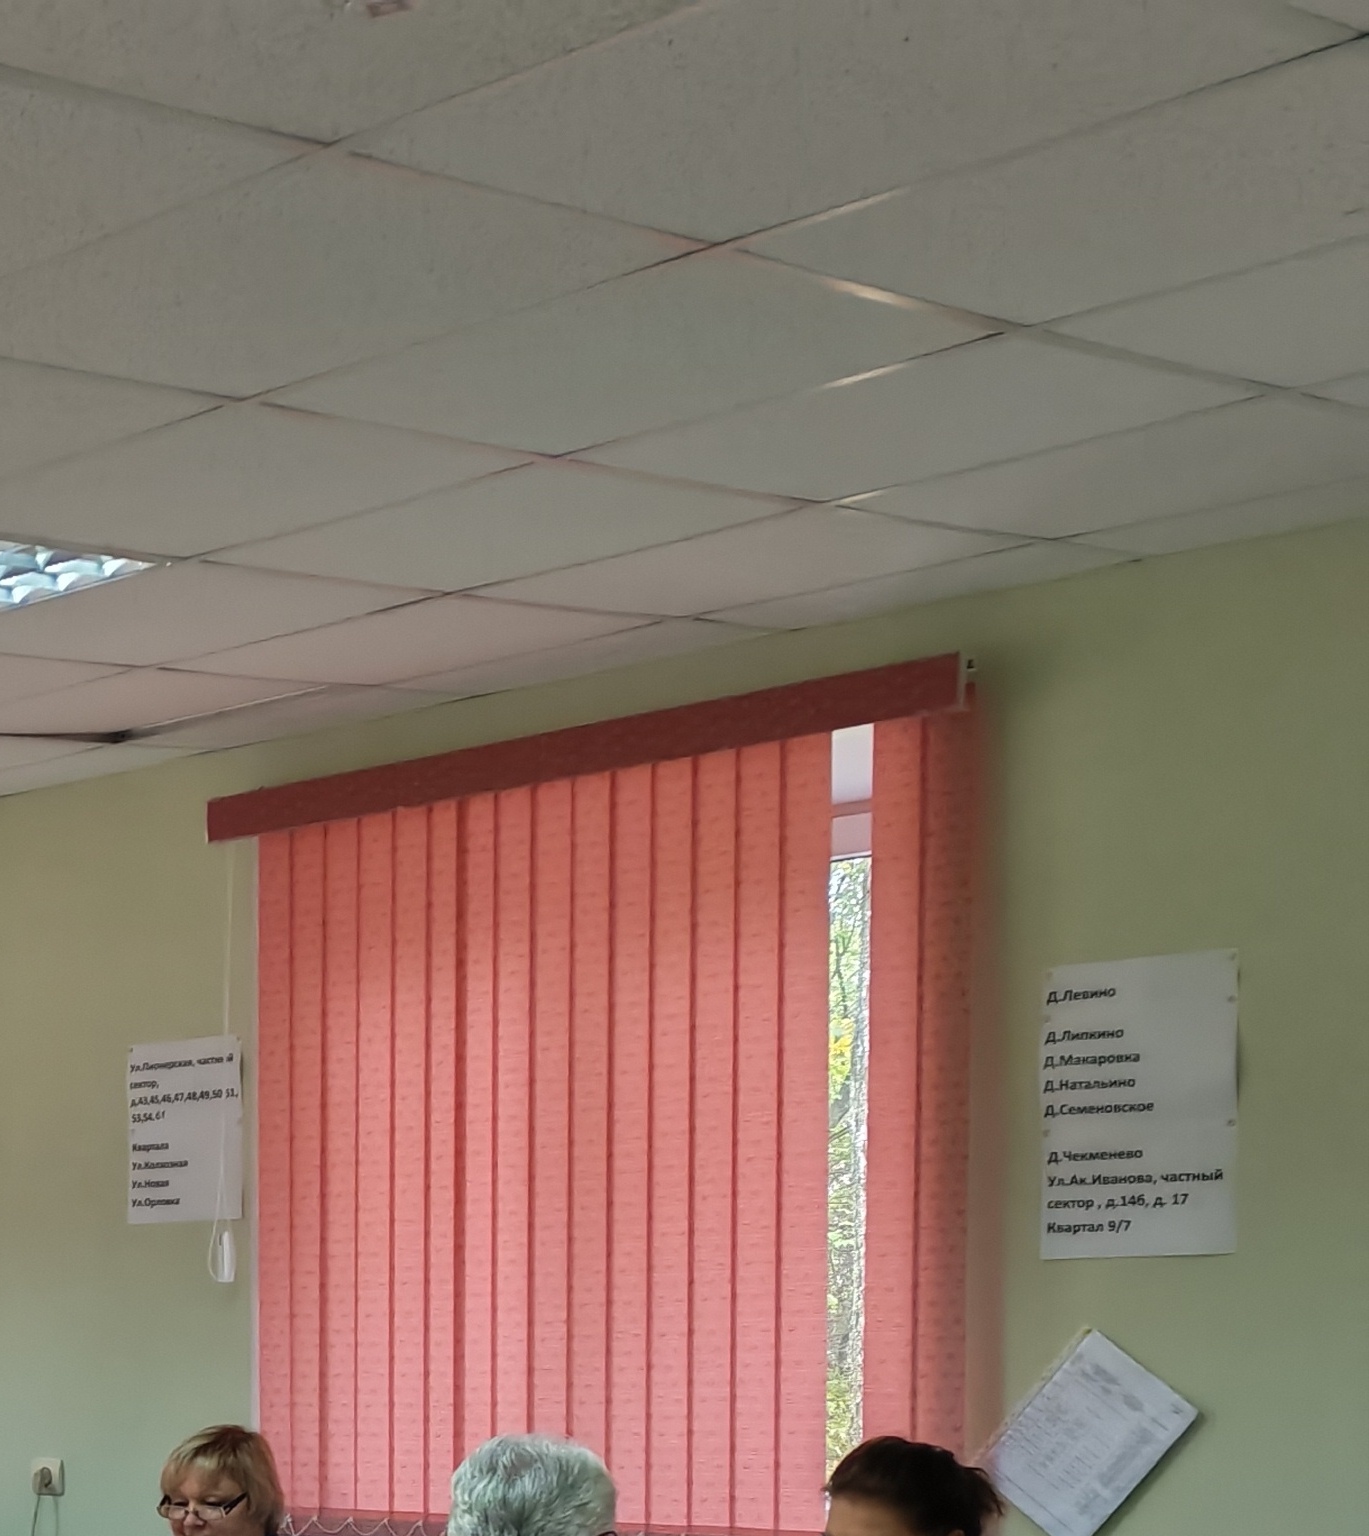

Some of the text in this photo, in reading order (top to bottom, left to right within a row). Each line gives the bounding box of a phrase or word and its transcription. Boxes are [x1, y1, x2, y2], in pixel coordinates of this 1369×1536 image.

[1046, 987, 1117, 1005] Д.Левино
[1044, 1028, 1125, 1045] Д.Липкино
[1043, 1051, 1141, 1070] Д.Макаровка
[1043, 1077, 1136, 1094] Д.Натальино
[1044, 1101, 1155, 1118] Д.Семеновское
[1047, 1148, 1144, 1164] Д.Чекменево
[1160, 1168, 1224, 1183] частный
[1171, 1193, 1190, 1206] 17
[1047, 1219, 1132, 1235] Квартал 9/7
